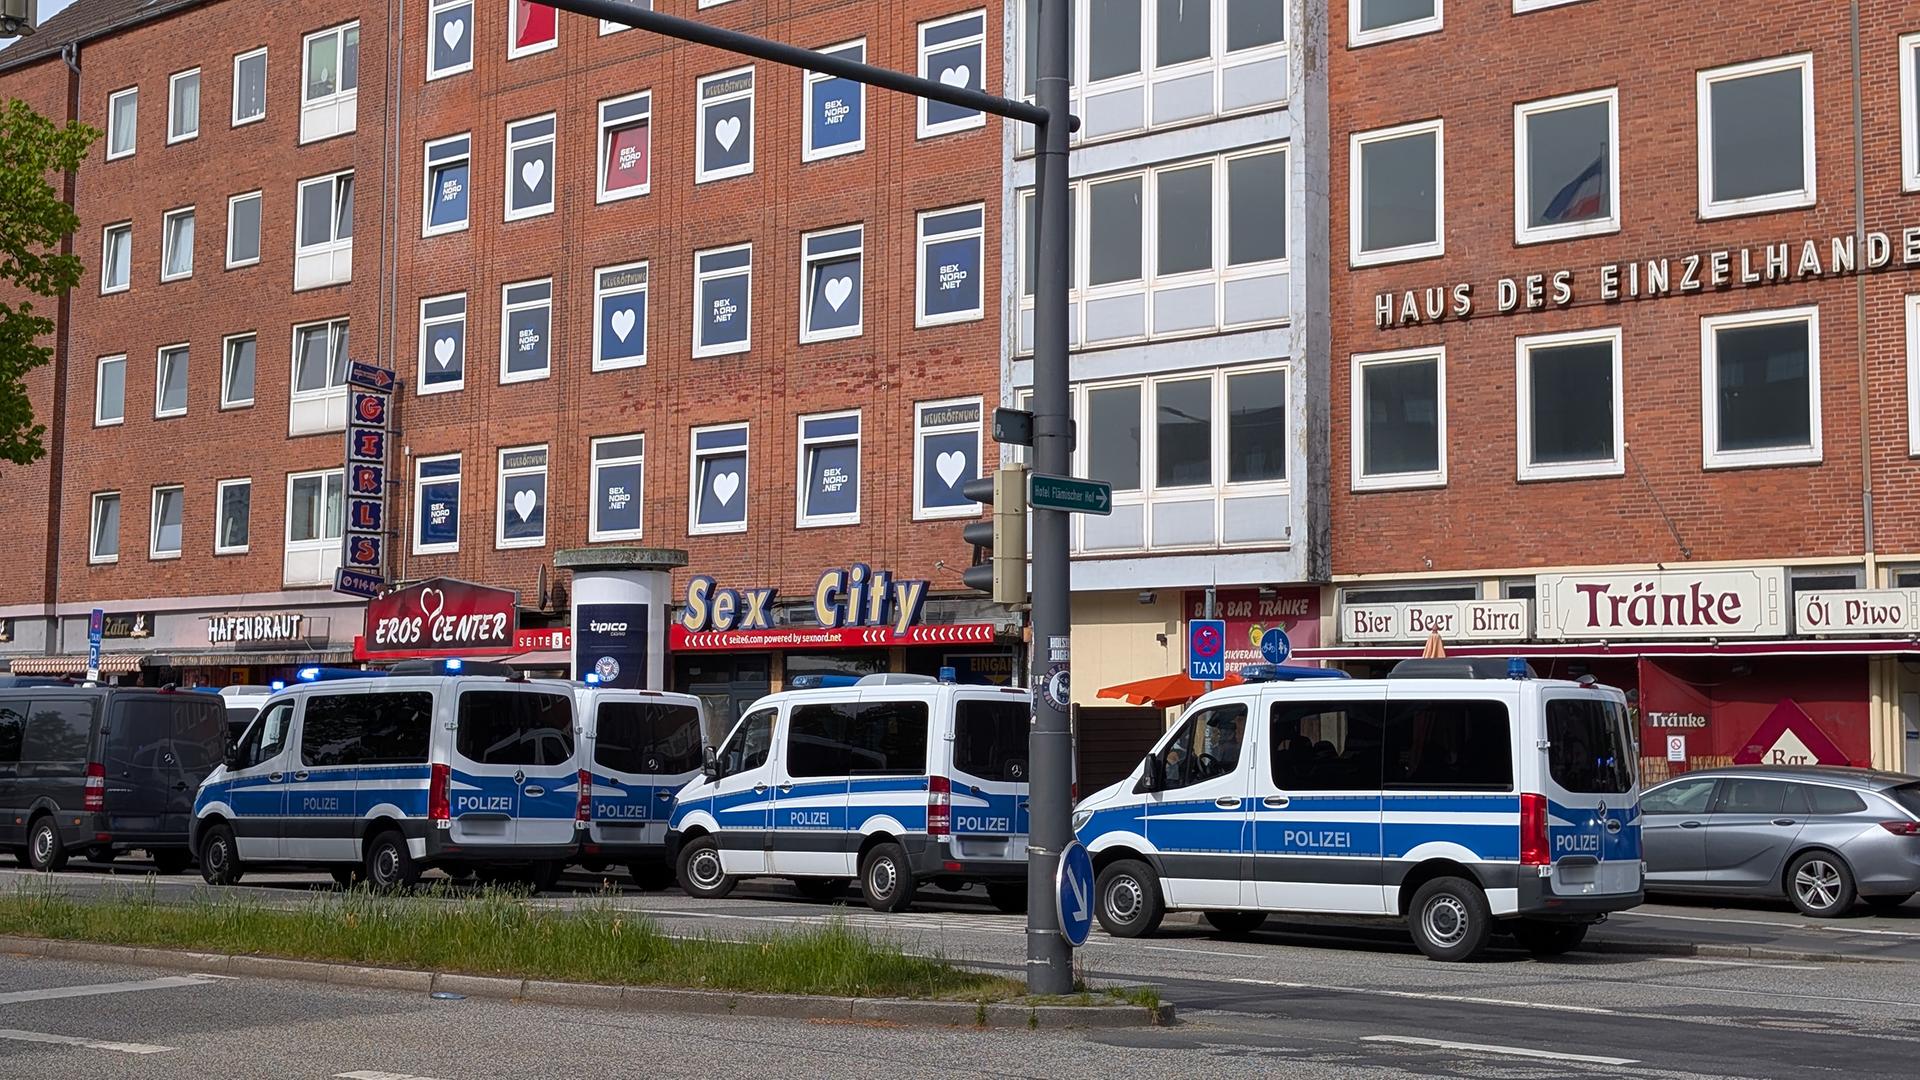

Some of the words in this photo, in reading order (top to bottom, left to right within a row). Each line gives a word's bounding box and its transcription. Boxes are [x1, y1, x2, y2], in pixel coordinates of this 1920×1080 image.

[825, 100, 842, 108] SEX
[825, 106, 849, 117] NORD
[825, 115, 844, 125] .NET
[620, 147, 635, 156] SEX
[619, 152, 640, 163] NORD
[619, 160, 636, 170] .NET
[443, 179, 457, 189] SEX
[443, 185, 461, 195] NORD
[940, 263, 958, 273] SEX
[940, 270, 967, 282] NORD
[1375, 282, 1472, 327] HAUS
[1497, 270, 1572, 311] DES
[1601, 226, 1920, 299] EINZELHANDE
[940, 280, 962, 290] .NET
[714, 298, 730, 307] SEX
[714, 305, 737, 315] NORD
[519, 329, 533, 337] SEX
[519, 335, 539, 344] NORD
[824, 468, 841, 477] SEX
[355, 396, 382, 562] GIRLS
[823, 475, 848, 484] NORD
[822, 483, 842, 492] .NET
[1034, 485, 1050, 496] Hotel
[609, 493, 630, 502] NORD
[431, 502, 445, 511] SEX
[609, 501, 626, 509] .NET
[431, 509, 450, 518] NORD
[681, 575, 777, 632] Sex
[814, 562, 930, 637] City
[1575, 581, 1742, 627] Tränke
[1194, 601, 1224, 617] BR
[1227, 600, 1253, 617] BAR
[1259, 596, 1309, 616] TRÄNKE
[1806, 596, 1830, 626] Öl
[1845, 599, 1901, 625] Piwo
[1354, 610, 1392, 633] Bier
[1409, 608, 1453, 632] Beer
[1472, 607, 1520, 631] Birra
[208, 614, 301, 643] HAFENBRAUT
[376, 616, 422, 644] EROS
[431, 612, 507, 643] CENTER
[590, 620, 628, 634] tipico
[519, 636, 551, 647] SEITE
[729, 634, 763, 645] seite6.com
[764, 633, 792, 645] powered
[793, 633, 802, 645] by
[802, 632, 842, 643] sexnord.net
[1193, 662, 1221, 674] TAXI
[1648, 711, 1706, 728] Tränke
[1772, 749, 1808, 765] Bar
[303, 797, 339, 810] POLIZEI
[457, 796, 512, 811] POLIZEI
[597, 804, 647, 818] POLIZEI
[790, 811, 830, 825] POLIZEI
[957, 816, 1010, 832] POLIZEI
[1284, 830, 1351, 848] POLIZEI
[1556, 834, 1600, 851] POLIZEI
